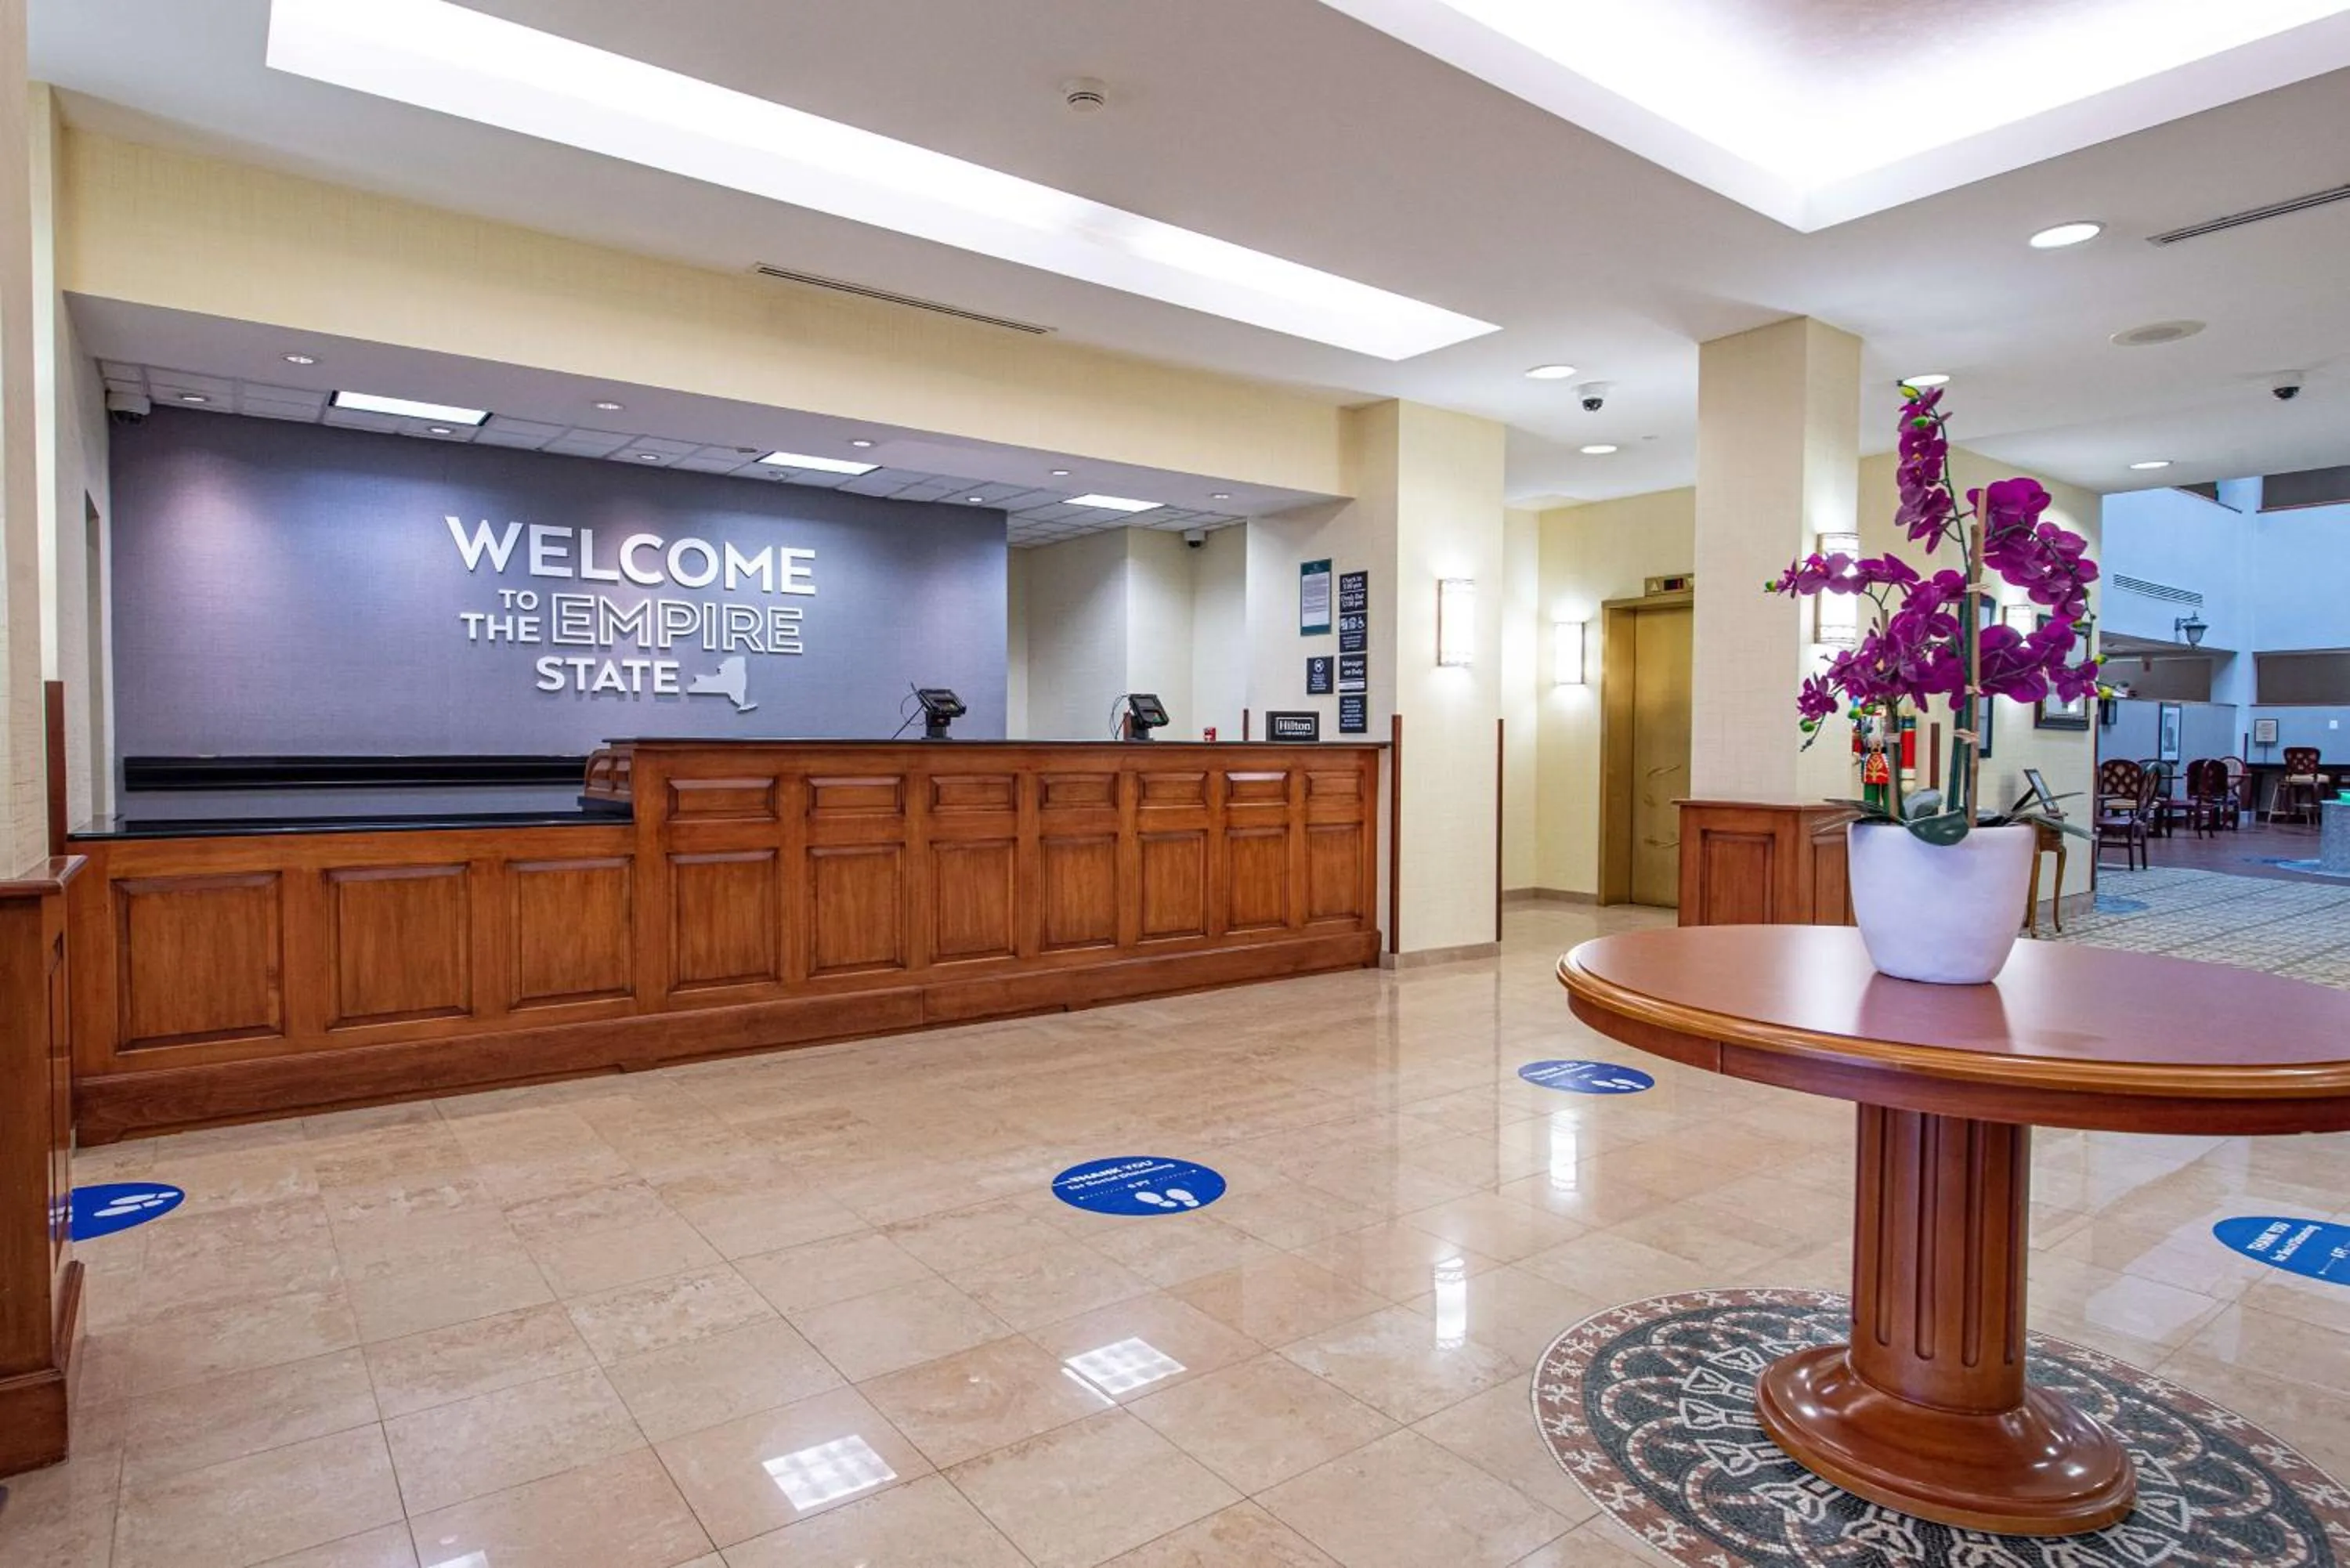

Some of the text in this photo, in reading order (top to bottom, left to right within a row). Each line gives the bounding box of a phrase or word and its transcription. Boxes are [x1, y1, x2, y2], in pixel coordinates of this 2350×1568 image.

[445, 515, 816, 595] WELCOME
[498, 588, 539, 611] TO
[460, 592, 804, 655] THE EMPIRE
[535, 656, 681, 695] STATE
[1279, 720, 1311, 732] Hilton
